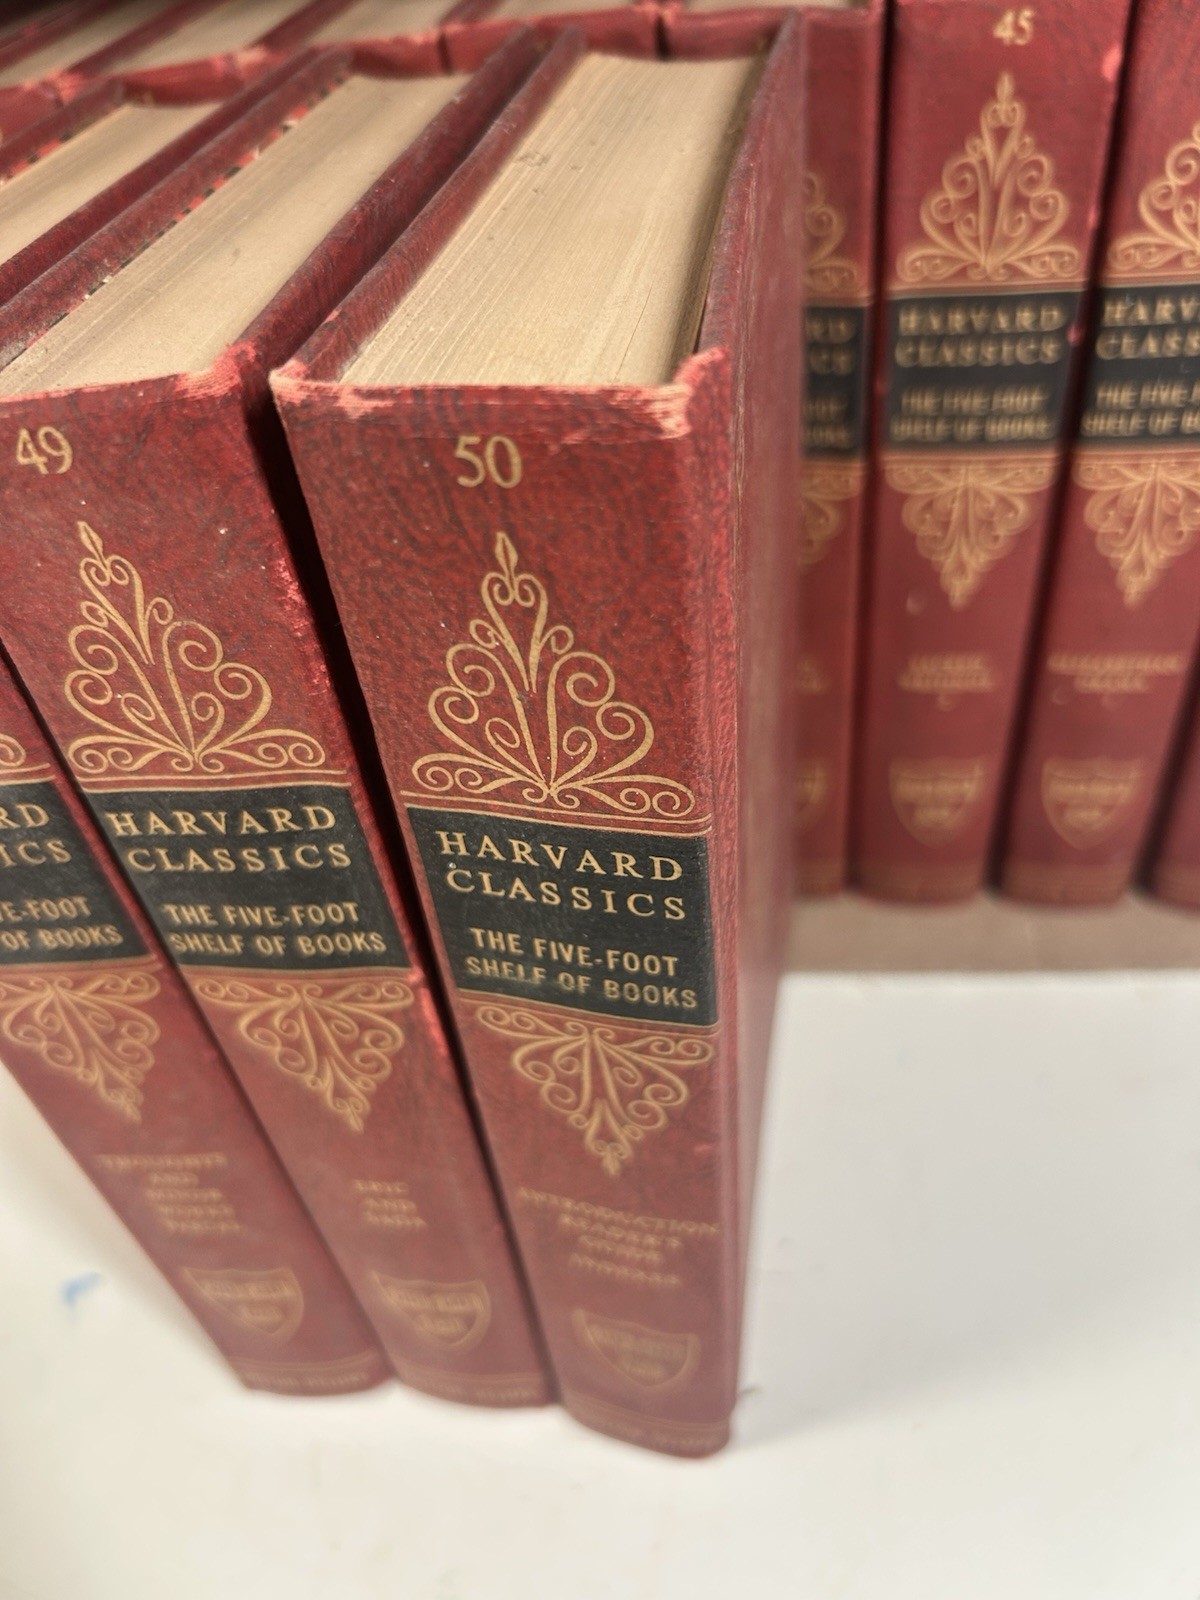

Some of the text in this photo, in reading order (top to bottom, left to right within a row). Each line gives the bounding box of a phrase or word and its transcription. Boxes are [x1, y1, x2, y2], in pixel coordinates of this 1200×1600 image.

[993, 9, 1034, 46] 45
[899, 303, 1066, 336] HARVARD
[896, 335, 1063, 368] CLASSICS
[15, 425, 73, 475] 49
[454, 435, 523, 489] 50
[105, 804, 337, 837] HARVARD
[127, 843, 352, 873] CLASSICS
[435, 830, 683, 882] HARVARD
[0, 896, 91, 922] E-FOOT
[446, 868, 686, 921] CLASSICS
[163, 901, 360, 928] THE FIVE-FOOT
[0, 924, 124, 951] OF BOOKS
[170, 931, 387, 957] SHELF OF BOOKS
[470, 926, 679, 978] THE FIVE-FOOT
[465, 956, 698, 1010] SHELF OF BOOKS
